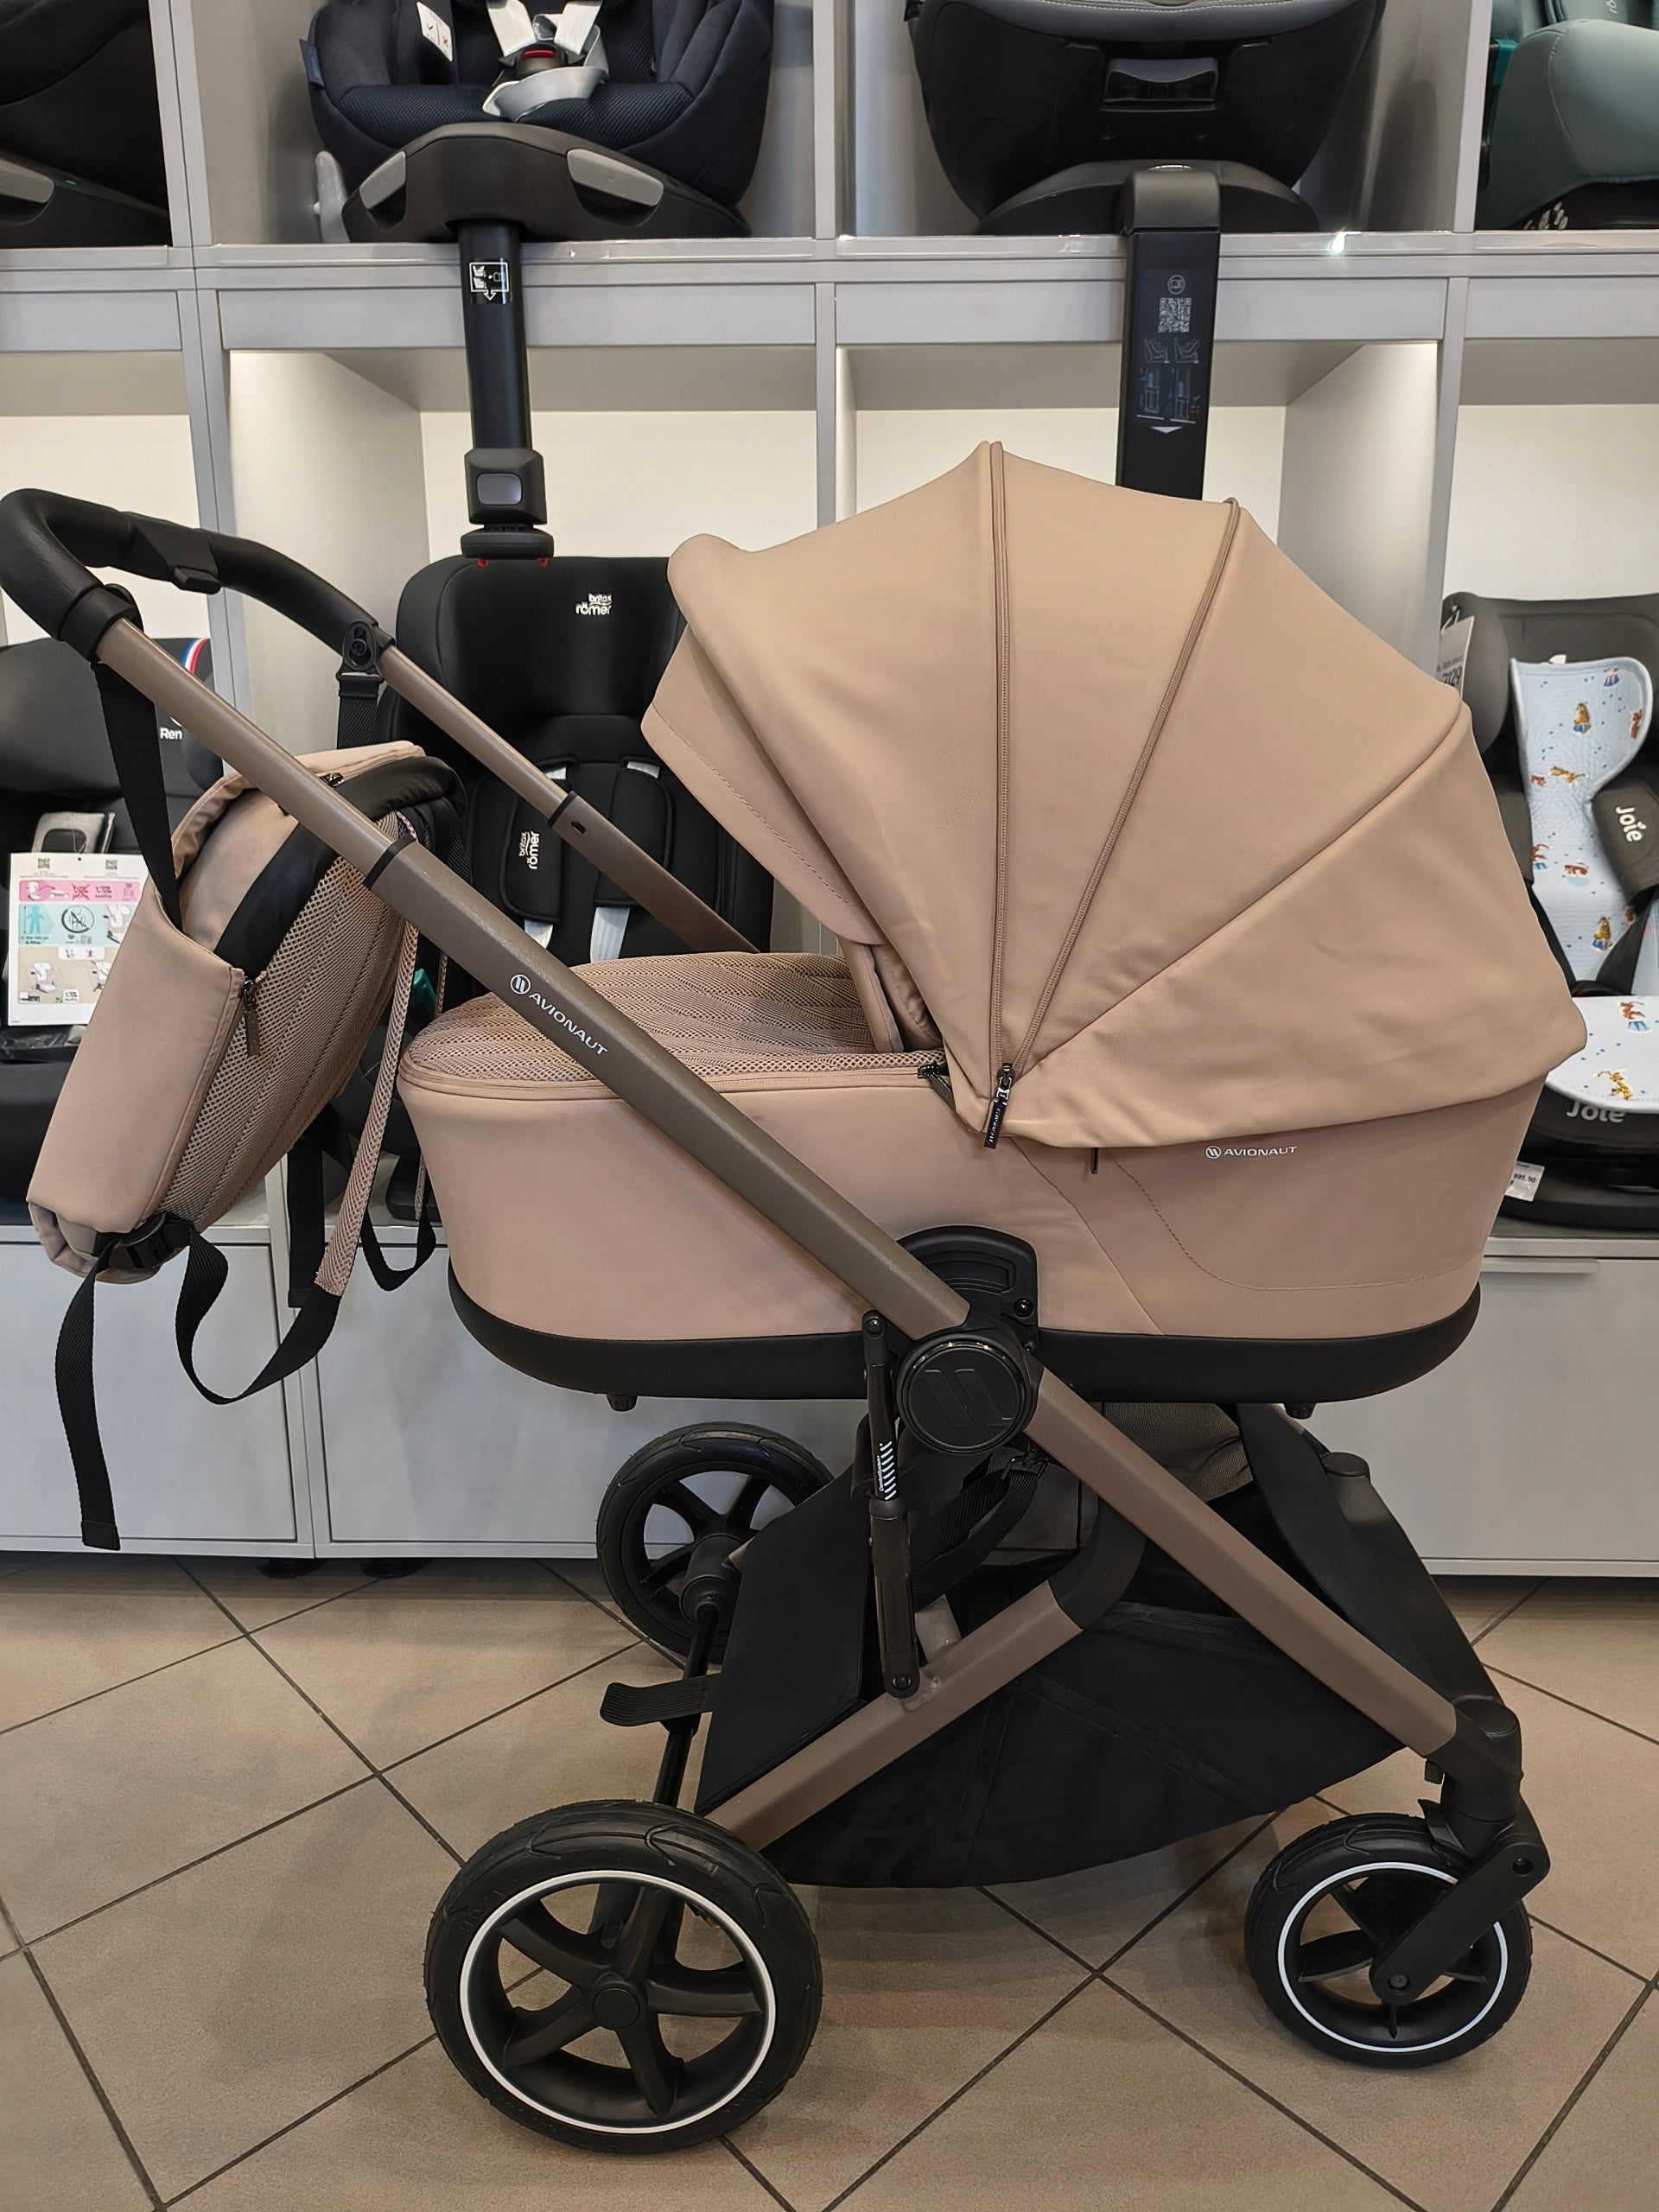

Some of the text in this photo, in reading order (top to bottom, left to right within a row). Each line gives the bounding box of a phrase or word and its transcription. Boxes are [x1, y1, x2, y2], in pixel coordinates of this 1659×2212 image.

[575, 601, 612, 615] römer
[588, 592, 613, 602] britax
[1616, 807, 1646, 842] Joie
[518, 831, 527, 856] britax
[526, 831, 540, 869] römer
[529, 993, 608, 1055] AVIONAUT
[1224, 1147, 1298, 1156] AVIONAUT
